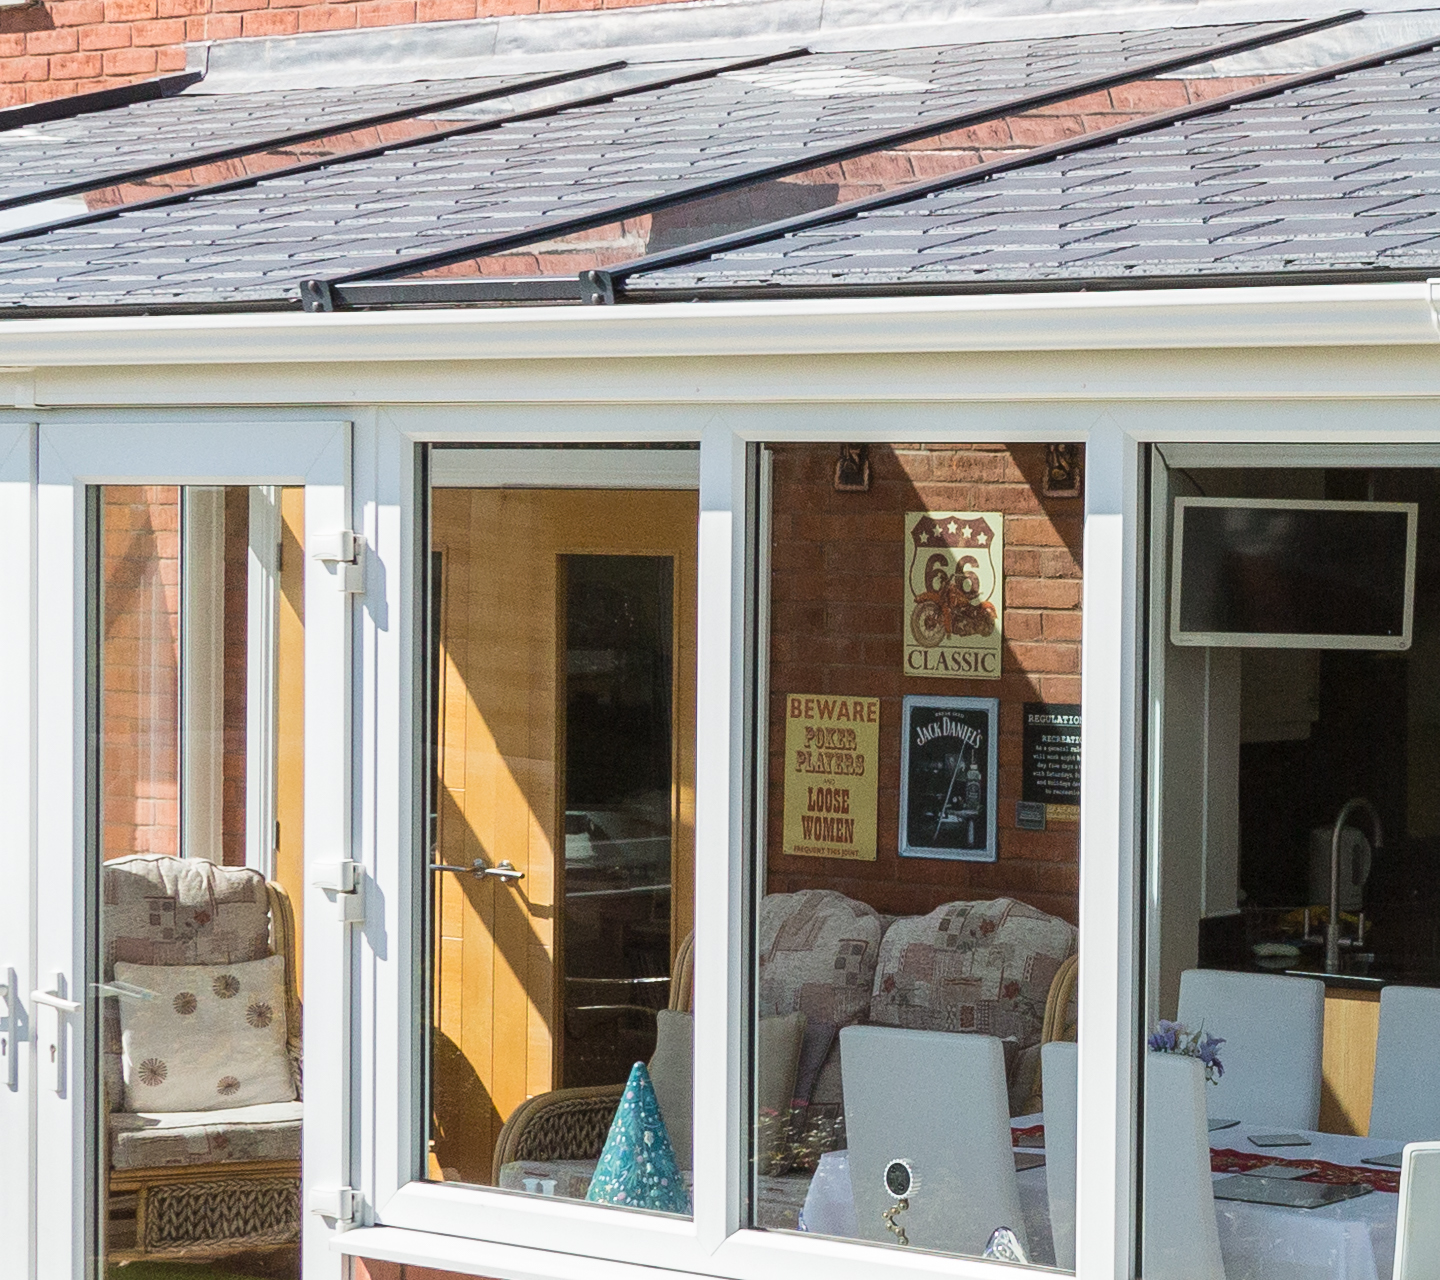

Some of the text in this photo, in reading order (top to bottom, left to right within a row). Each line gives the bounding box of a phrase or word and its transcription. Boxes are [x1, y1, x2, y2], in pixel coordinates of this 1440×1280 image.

[925, 553, 980, 600] 66
[907, 649, 996, 673] CLASSIC
[790, 698, 877, 723] BEWARE
[804, 726, 857, 751] POKER
[916, 716, 983, 749] JACK DANIEL'S
[795, 750, 865, 777] PLAYERS
[807, 786, 850, 814] LOOSE
[801, 815, 855, 844] WOMEN
